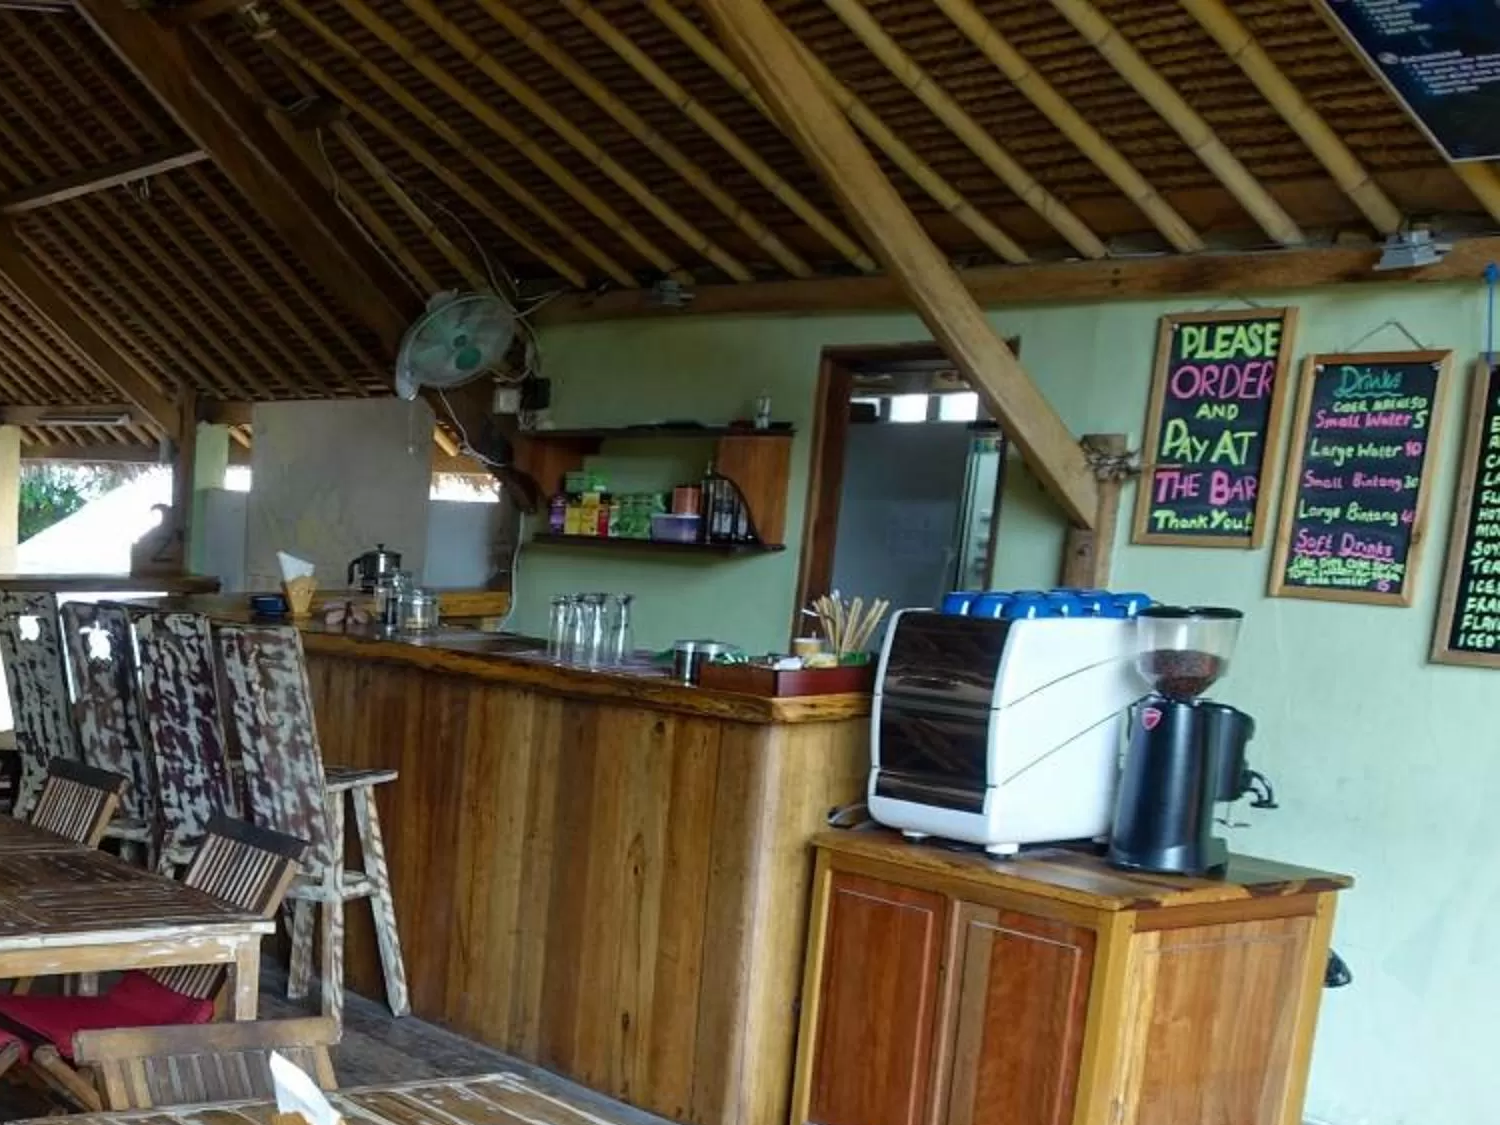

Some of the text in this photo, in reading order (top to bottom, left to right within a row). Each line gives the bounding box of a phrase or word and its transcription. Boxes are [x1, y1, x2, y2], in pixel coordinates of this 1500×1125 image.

[1181, 322, 1280, 359] PLEASE
[1171, 360, 1274, 399] ORDER
[1195, 403, 1239, 420] AND
[1161, 418, 1258, 465] PAY AT
[1155, 470, 1257, 505] THE BAR
[1153, 509, 1209, 530] Thank
